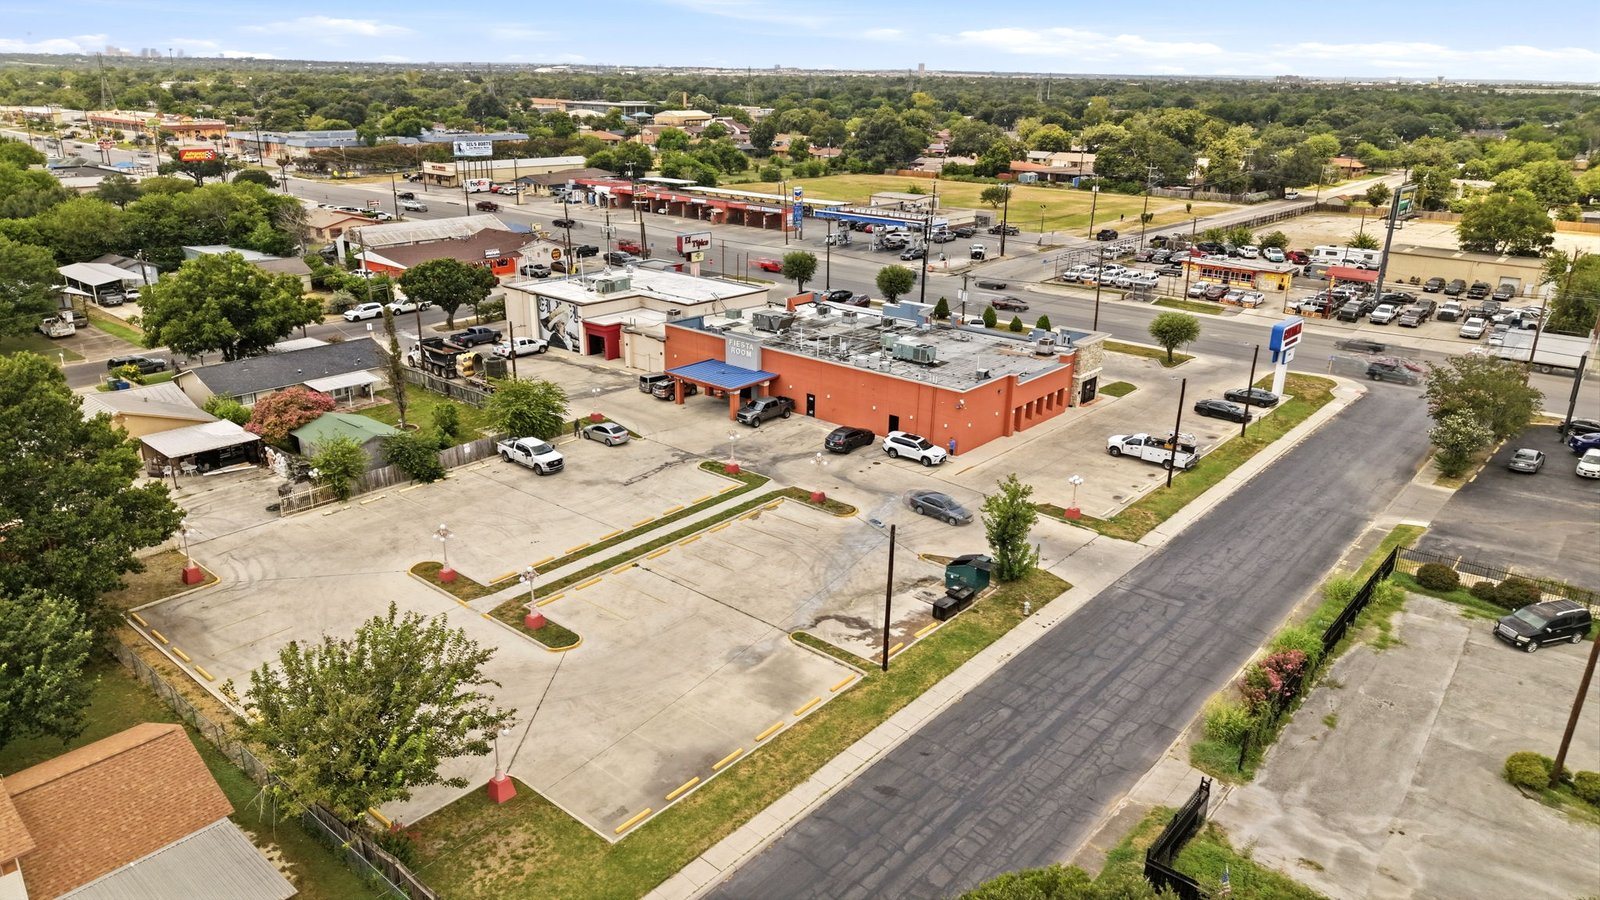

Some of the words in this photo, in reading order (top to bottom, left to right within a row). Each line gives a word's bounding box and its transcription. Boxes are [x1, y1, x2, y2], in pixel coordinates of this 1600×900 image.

[684, 236, 691, 244] El
[728, 338, 754, 351] FIESTA
[730, 347, 752, 358] ROOM
